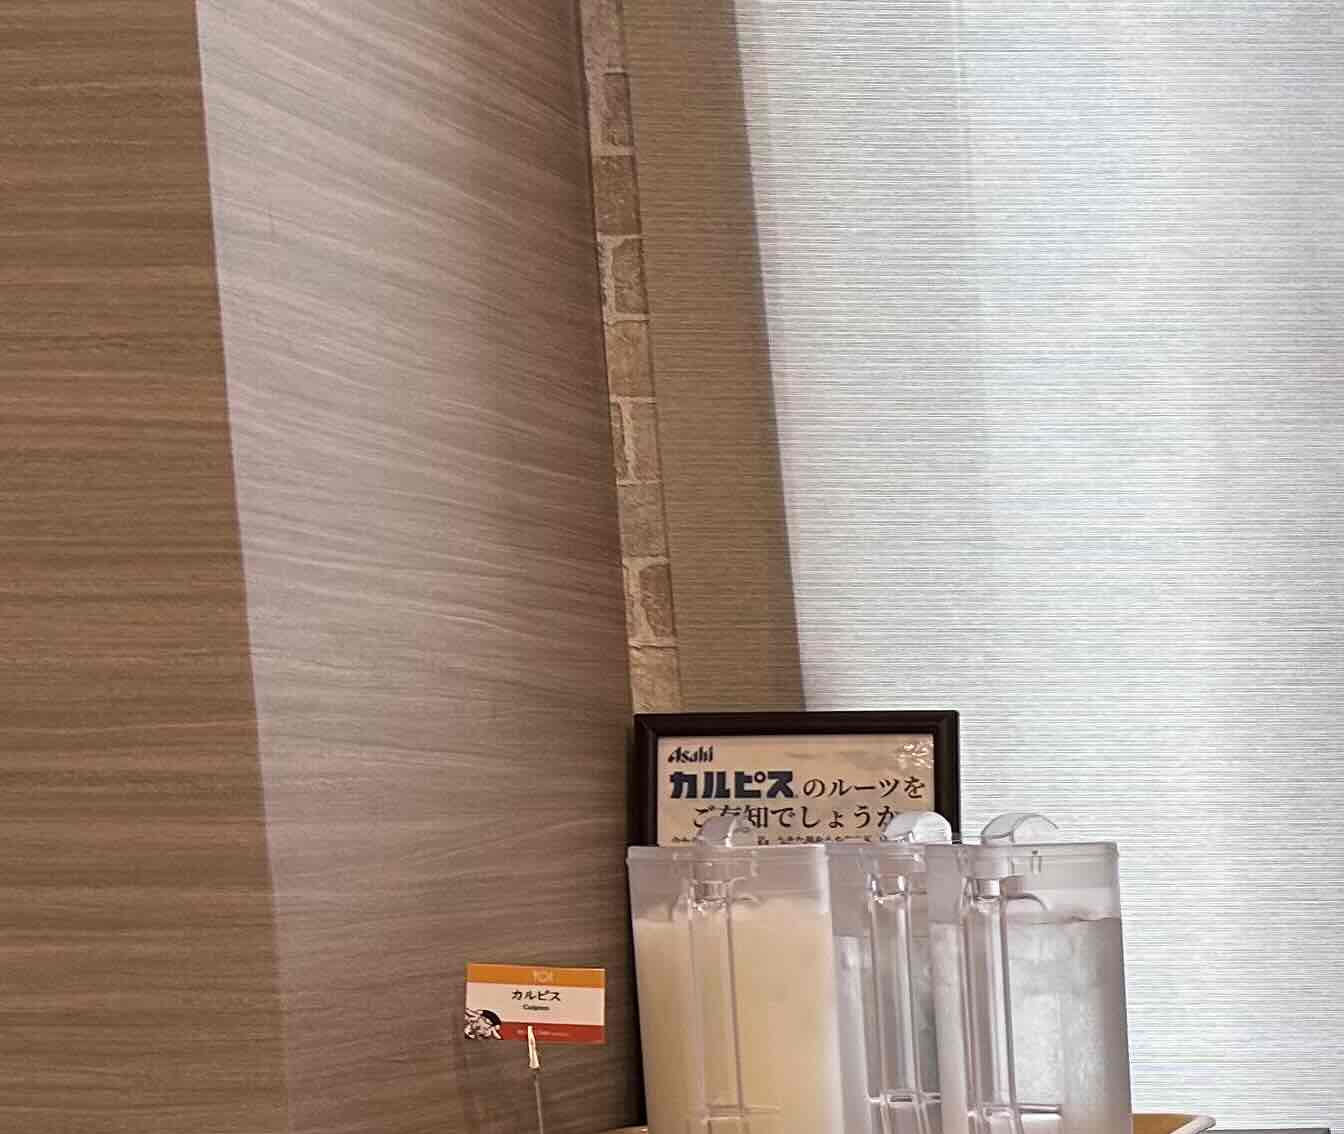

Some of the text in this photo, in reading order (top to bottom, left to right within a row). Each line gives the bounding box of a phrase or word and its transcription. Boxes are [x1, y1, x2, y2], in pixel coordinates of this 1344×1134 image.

[668, 745, 713, 763] Asahi
[511, 989, 561, 1002] カルピス
